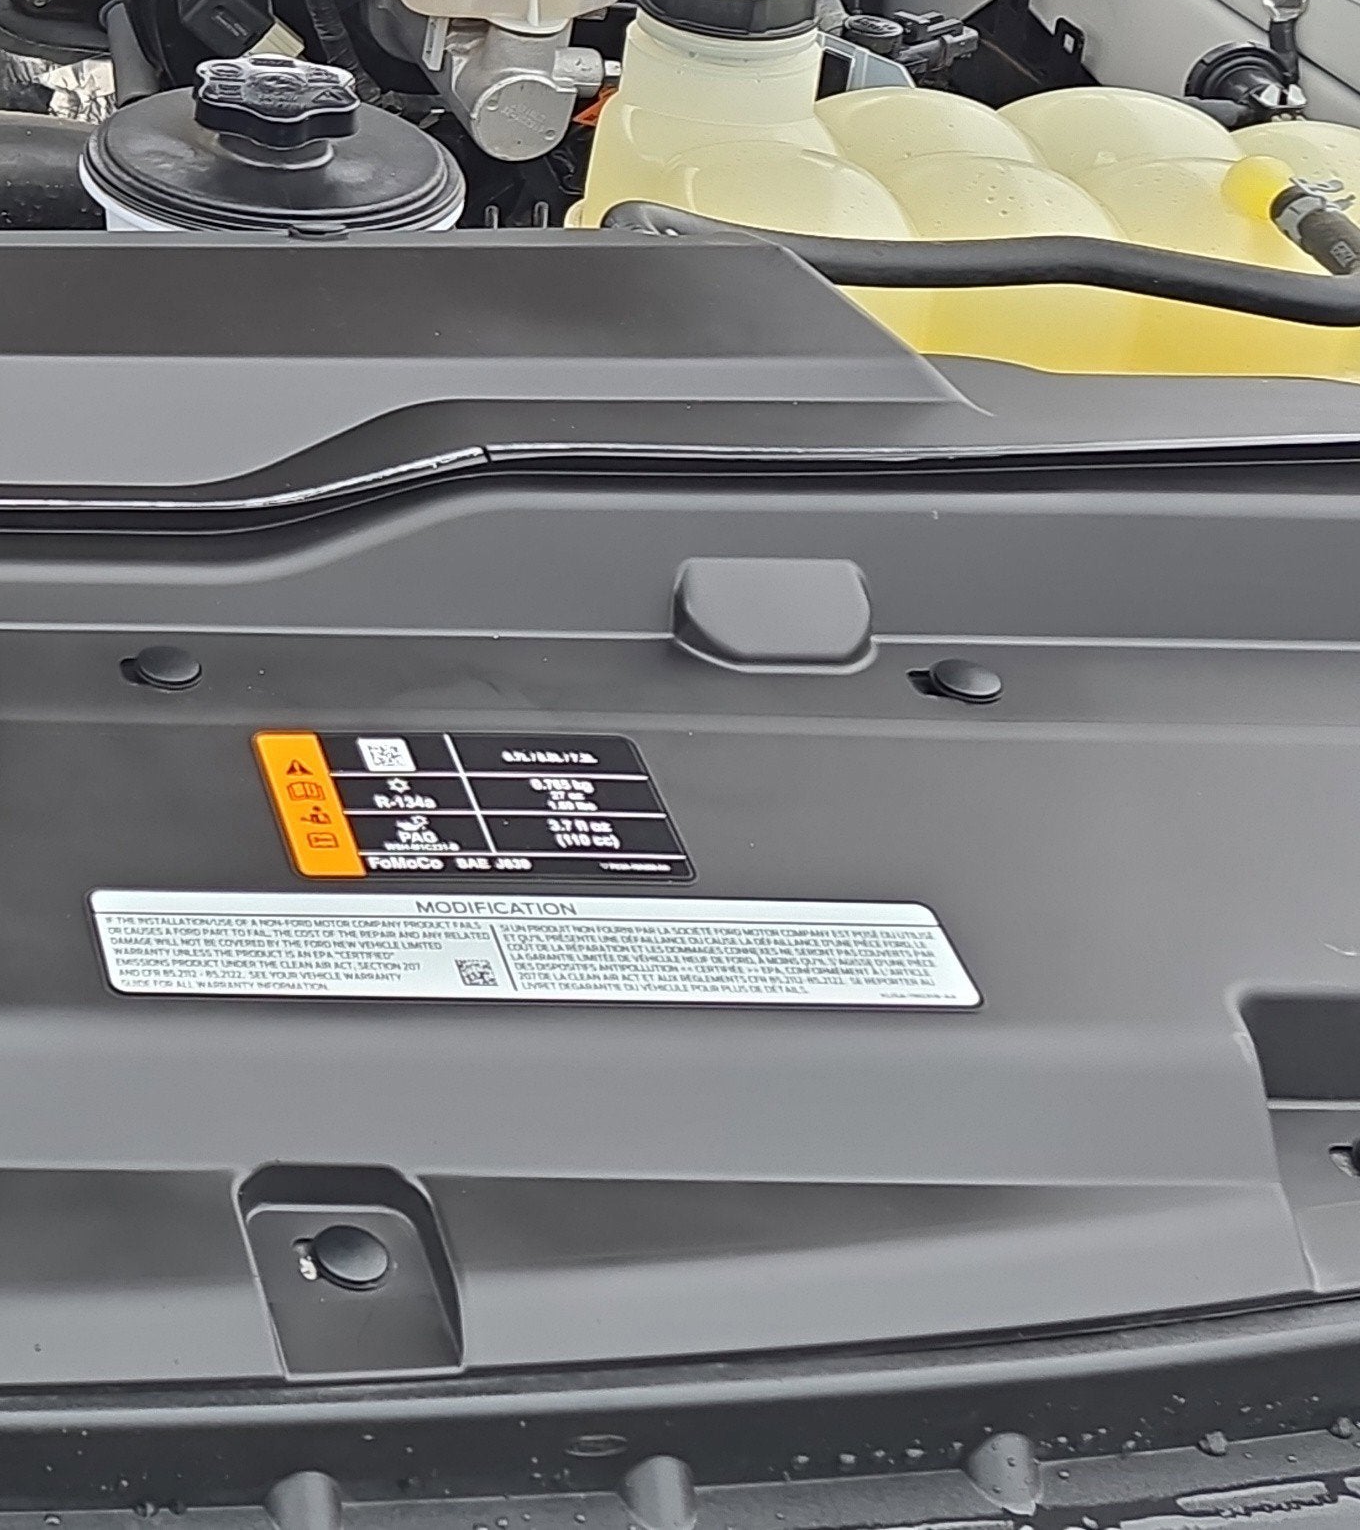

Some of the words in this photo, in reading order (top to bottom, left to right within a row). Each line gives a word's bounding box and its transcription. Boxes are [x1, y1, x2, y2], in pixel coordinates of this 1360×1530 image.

[373, 794, 437, 809] R-134a
[546, 818, 572, 832] 3.7
[592, 834, 621, 849] cc)
[366, 856, 444, 870] FoMoCo
[454, 857, 492, 870] SAE
[415, 901, 577, 915] MODIFICATION
